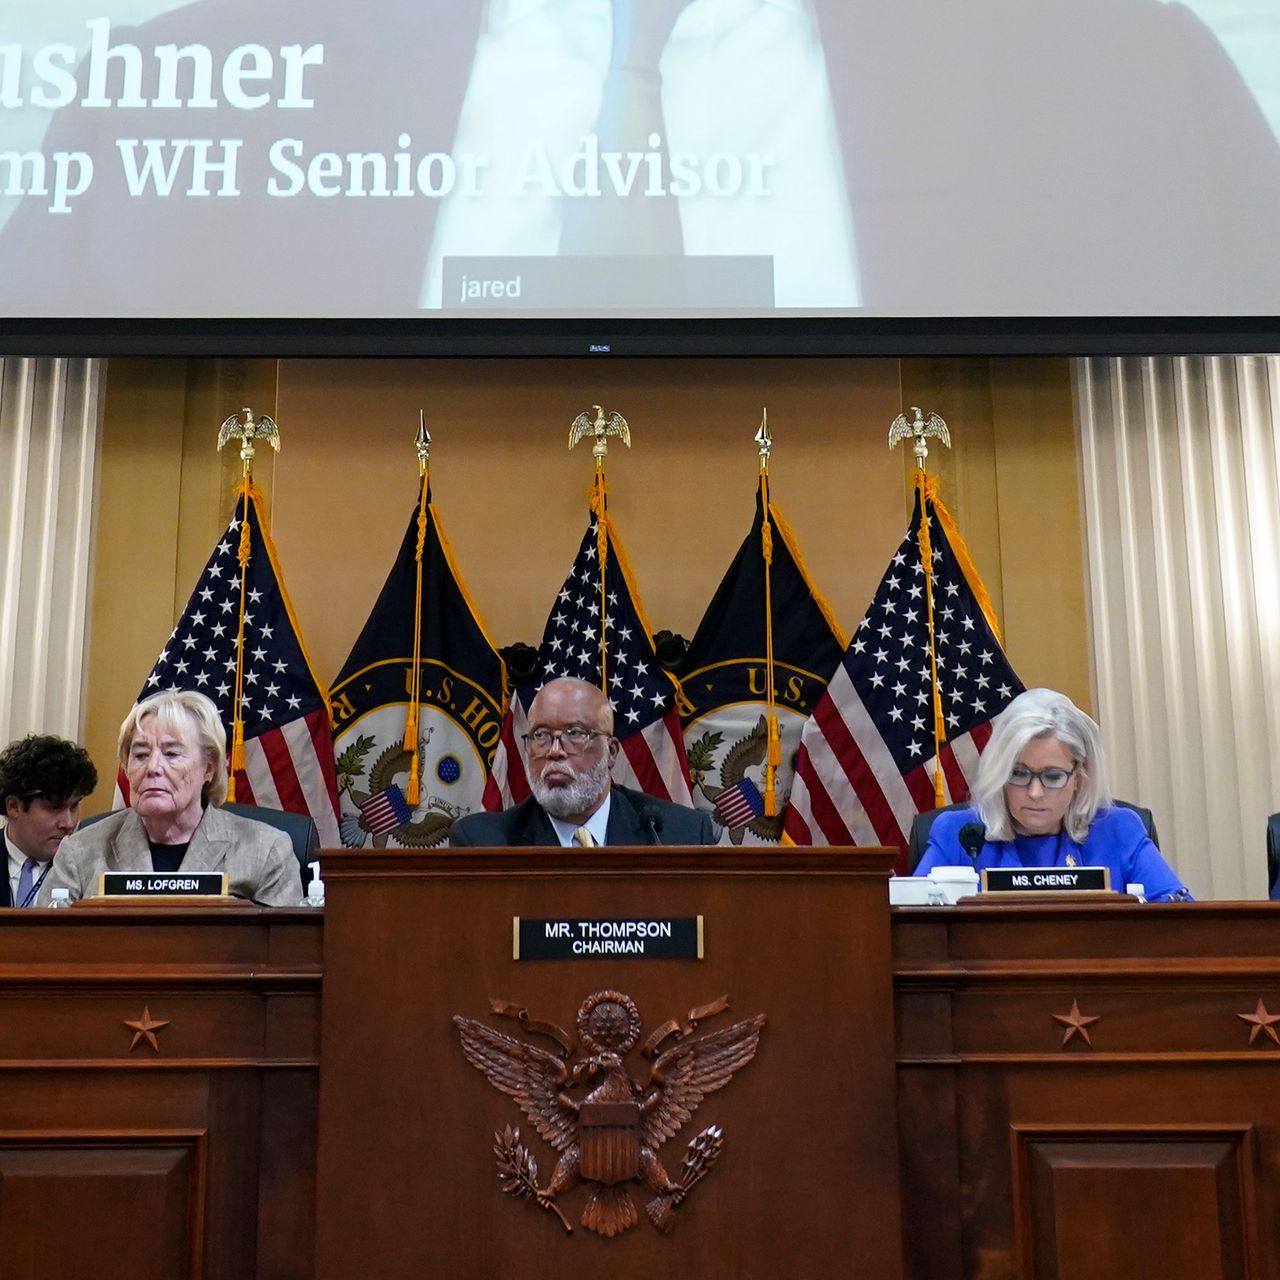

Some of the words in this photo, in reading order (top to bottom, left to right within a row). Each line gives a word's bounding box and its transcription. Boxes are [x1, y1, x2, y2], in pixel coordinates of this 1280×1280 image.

[116, 138, 243, 197] WH
[267, 133, 489, 198] Senior
[517, 133, 777, 198] Advisor
[460, 274, 521, 303] jared
[126, 879, 145, 891] MS.
[147, 879, 199, 890] LOFGREN
[1012, 875, 1032, 886] MS.
[1034, 874, 1078, 885] CHENEY
[545, 922, 574, 938] MR.
[578, 921, 672, 938] THOMPSON
[572, 940, 644, 954] CHAIRMAN
